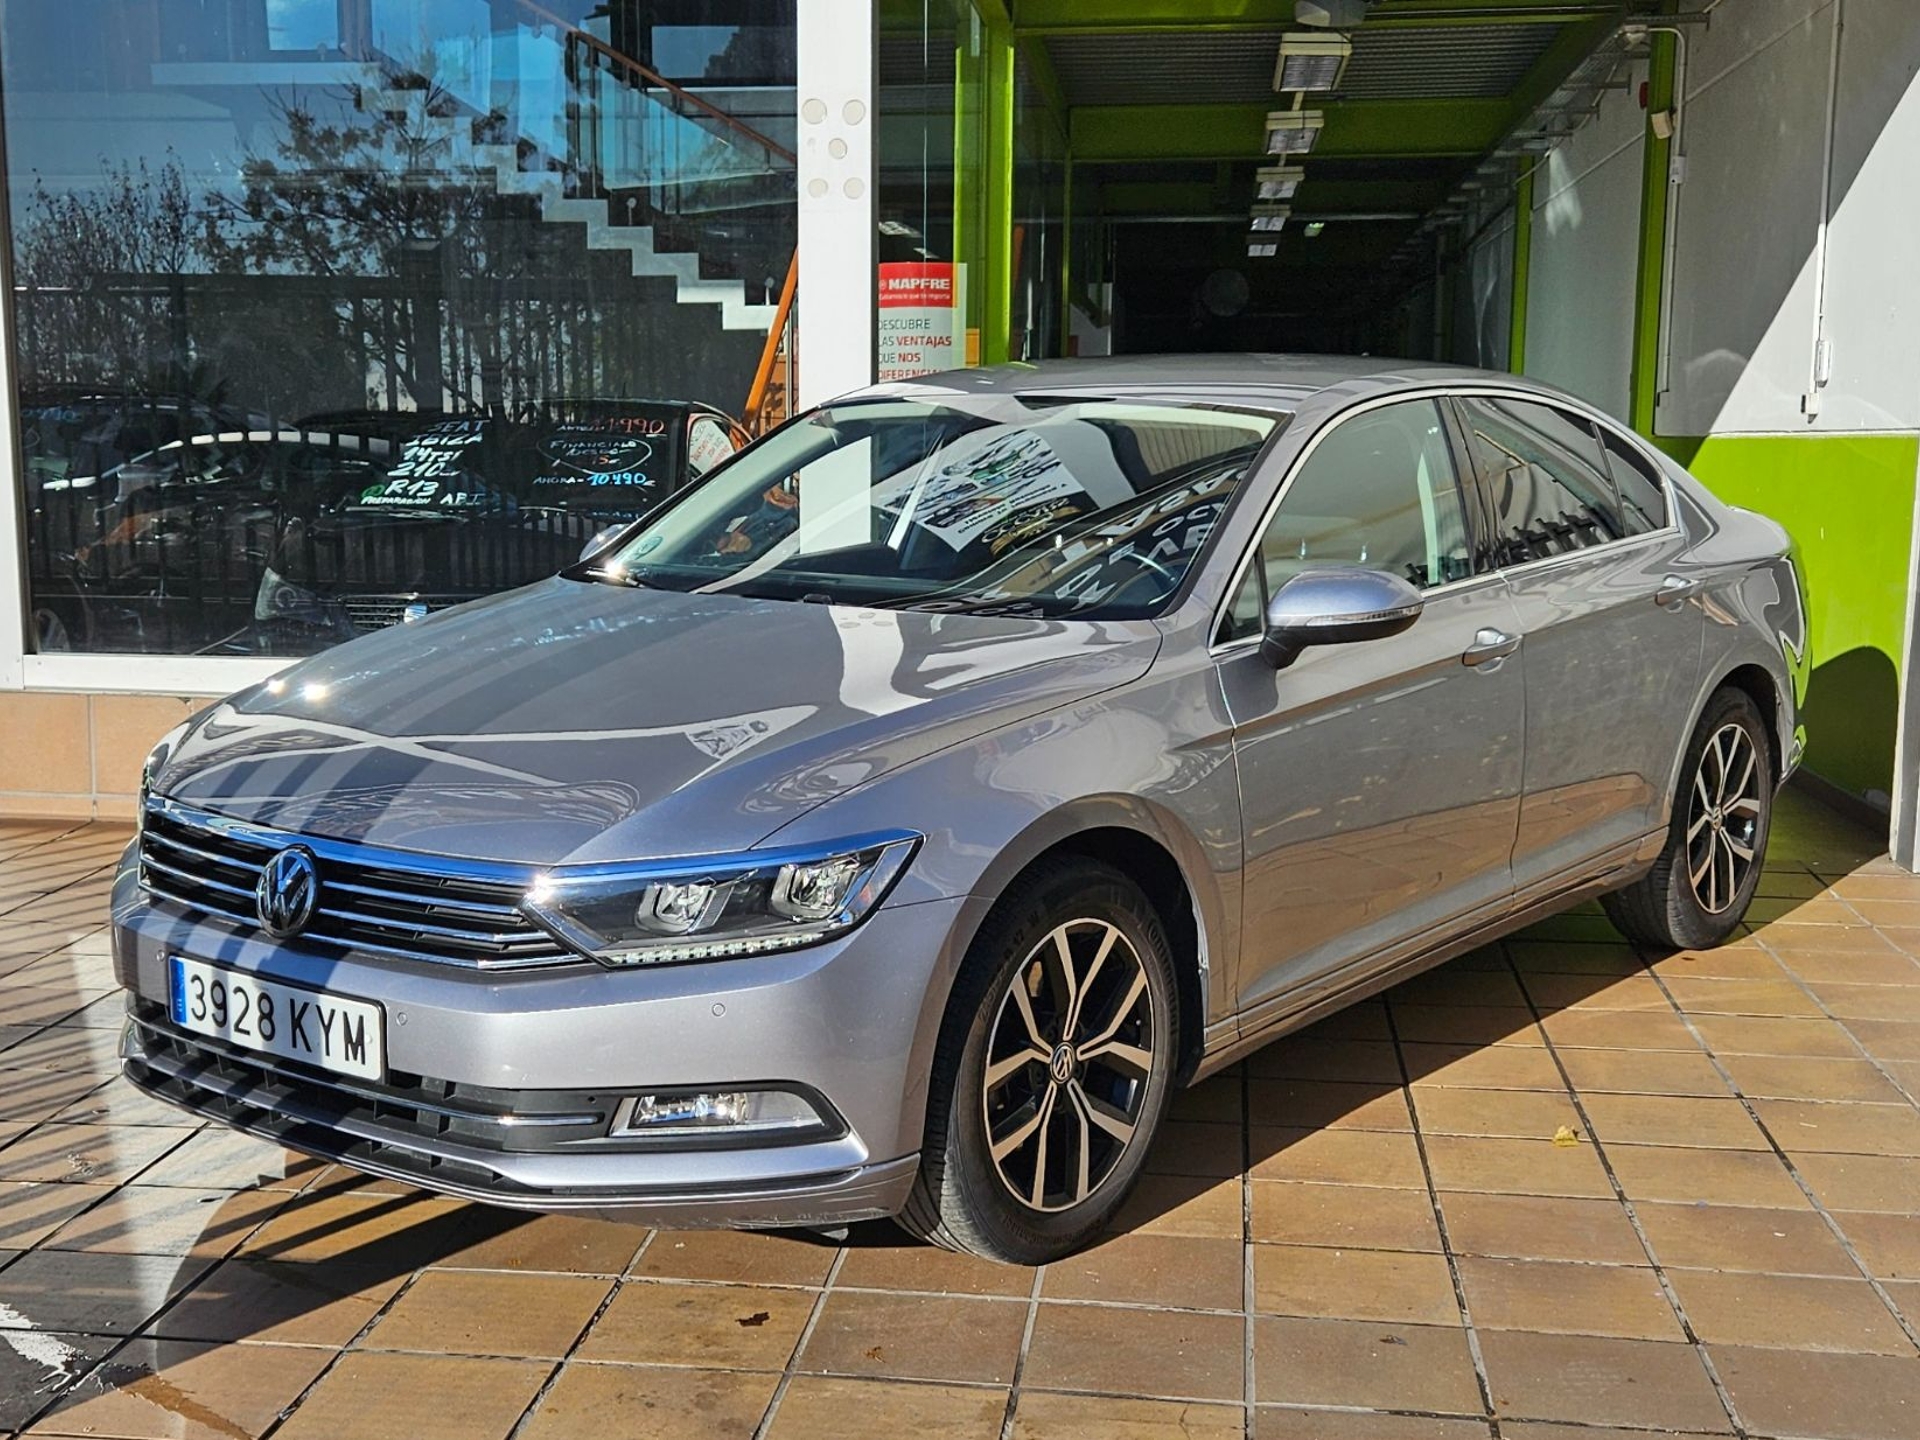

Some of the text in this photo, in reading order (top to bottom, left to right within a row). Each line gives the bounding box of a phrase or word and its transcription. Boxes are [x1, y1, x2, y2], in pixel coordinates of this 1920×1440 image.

[888, 278, 951, 290] MAPFRE
[897, 336, 952, 348] VENTAJAS
[898, 353, 921, 363] NOS
[190, 974, 276, 1042] 3928
[289, 998, 366, 1065] KYM
